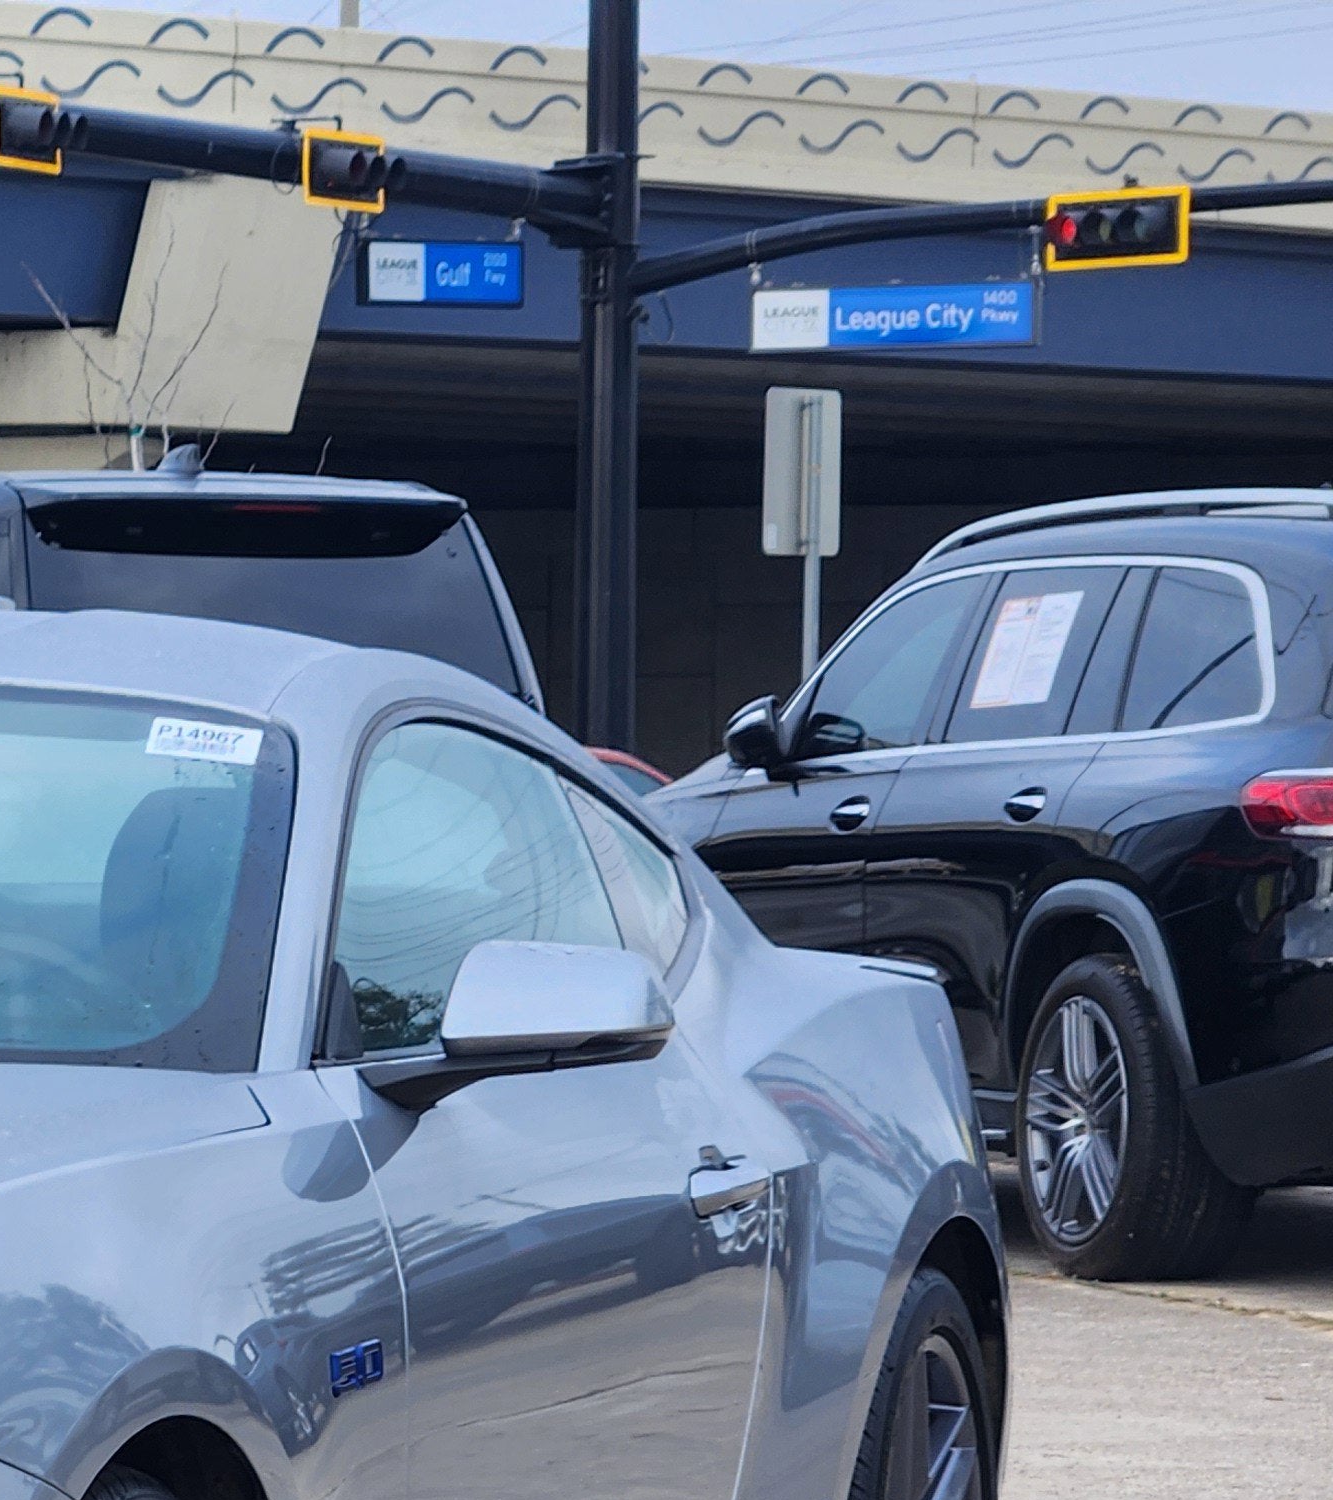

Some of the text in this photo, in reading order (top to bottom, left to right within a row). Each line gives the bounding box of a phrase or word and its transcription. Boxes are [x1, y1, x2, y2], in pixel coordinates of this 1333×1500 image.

[375, 257, 418, 271] LEAGUE
[435, 261, 471, 287] Gulf
[763, 306, 820, 319] LEAGUE
[835, 302, 974, 337] League City
[157, 724, 245, 746] P14967
[329, 1338, 384, 1398] 5.0
